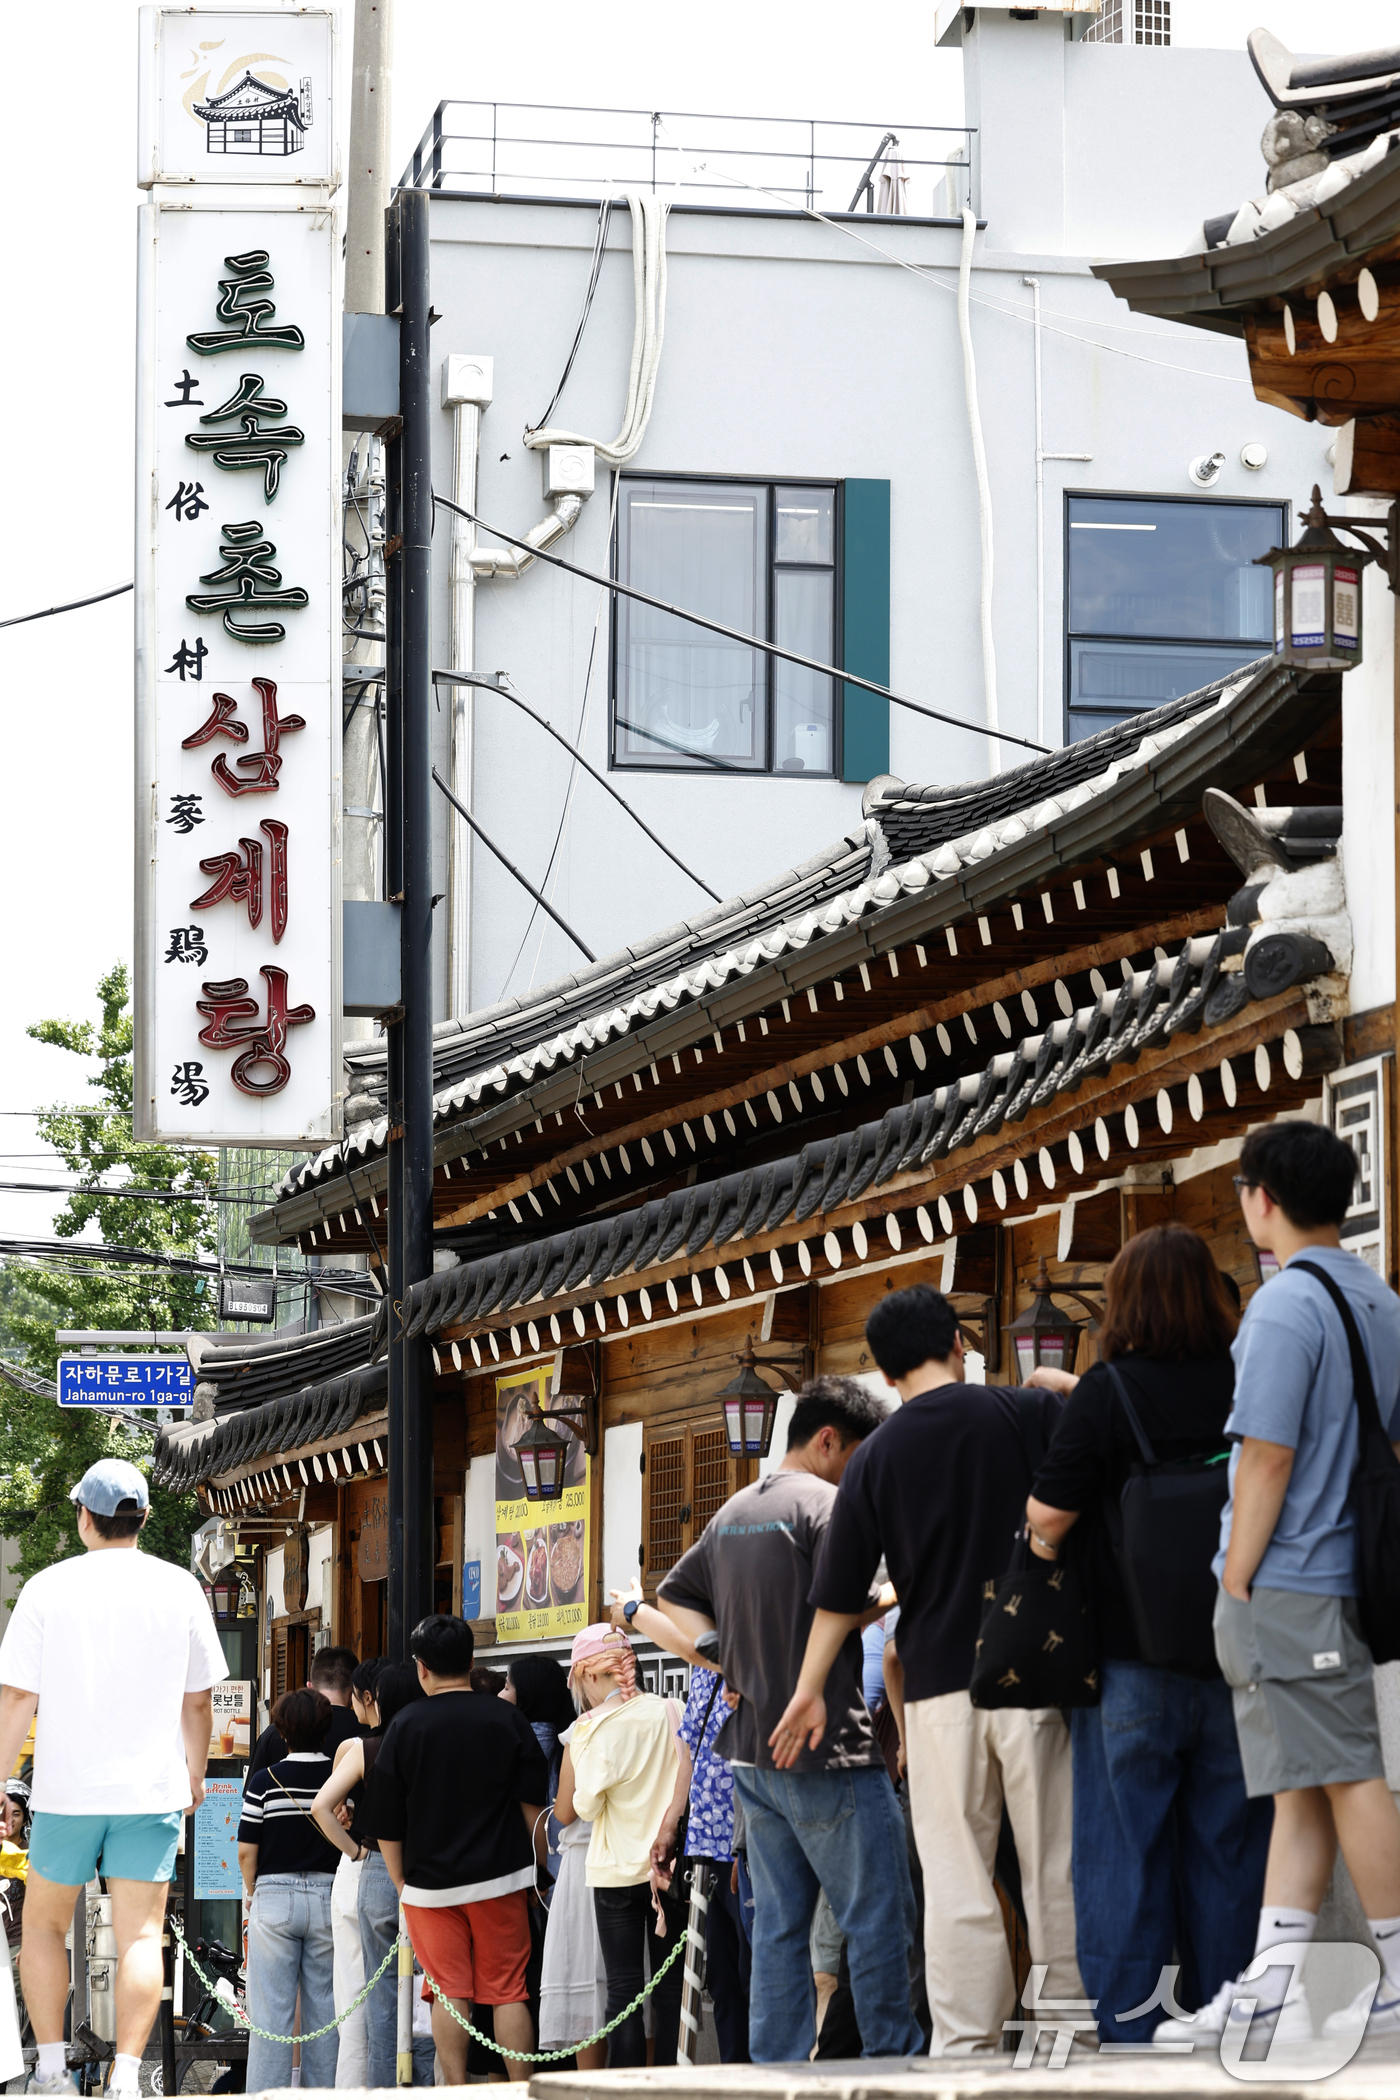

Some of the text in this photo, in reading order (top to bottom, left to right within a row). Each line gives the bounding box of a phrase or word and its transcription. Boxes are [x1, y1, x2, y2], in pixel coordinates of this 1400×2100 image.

[181, 250, 316, 1097] 토속촌 삼계탕
[65, 1364, 191, 1386] 자하문로1가길
[65, 1388, 194, 1405] Jahamun-ro 1ga-gi
[565, 1491, 586, 1508] 25,000
[213, 1694, 244, 1708] 롯보틀
